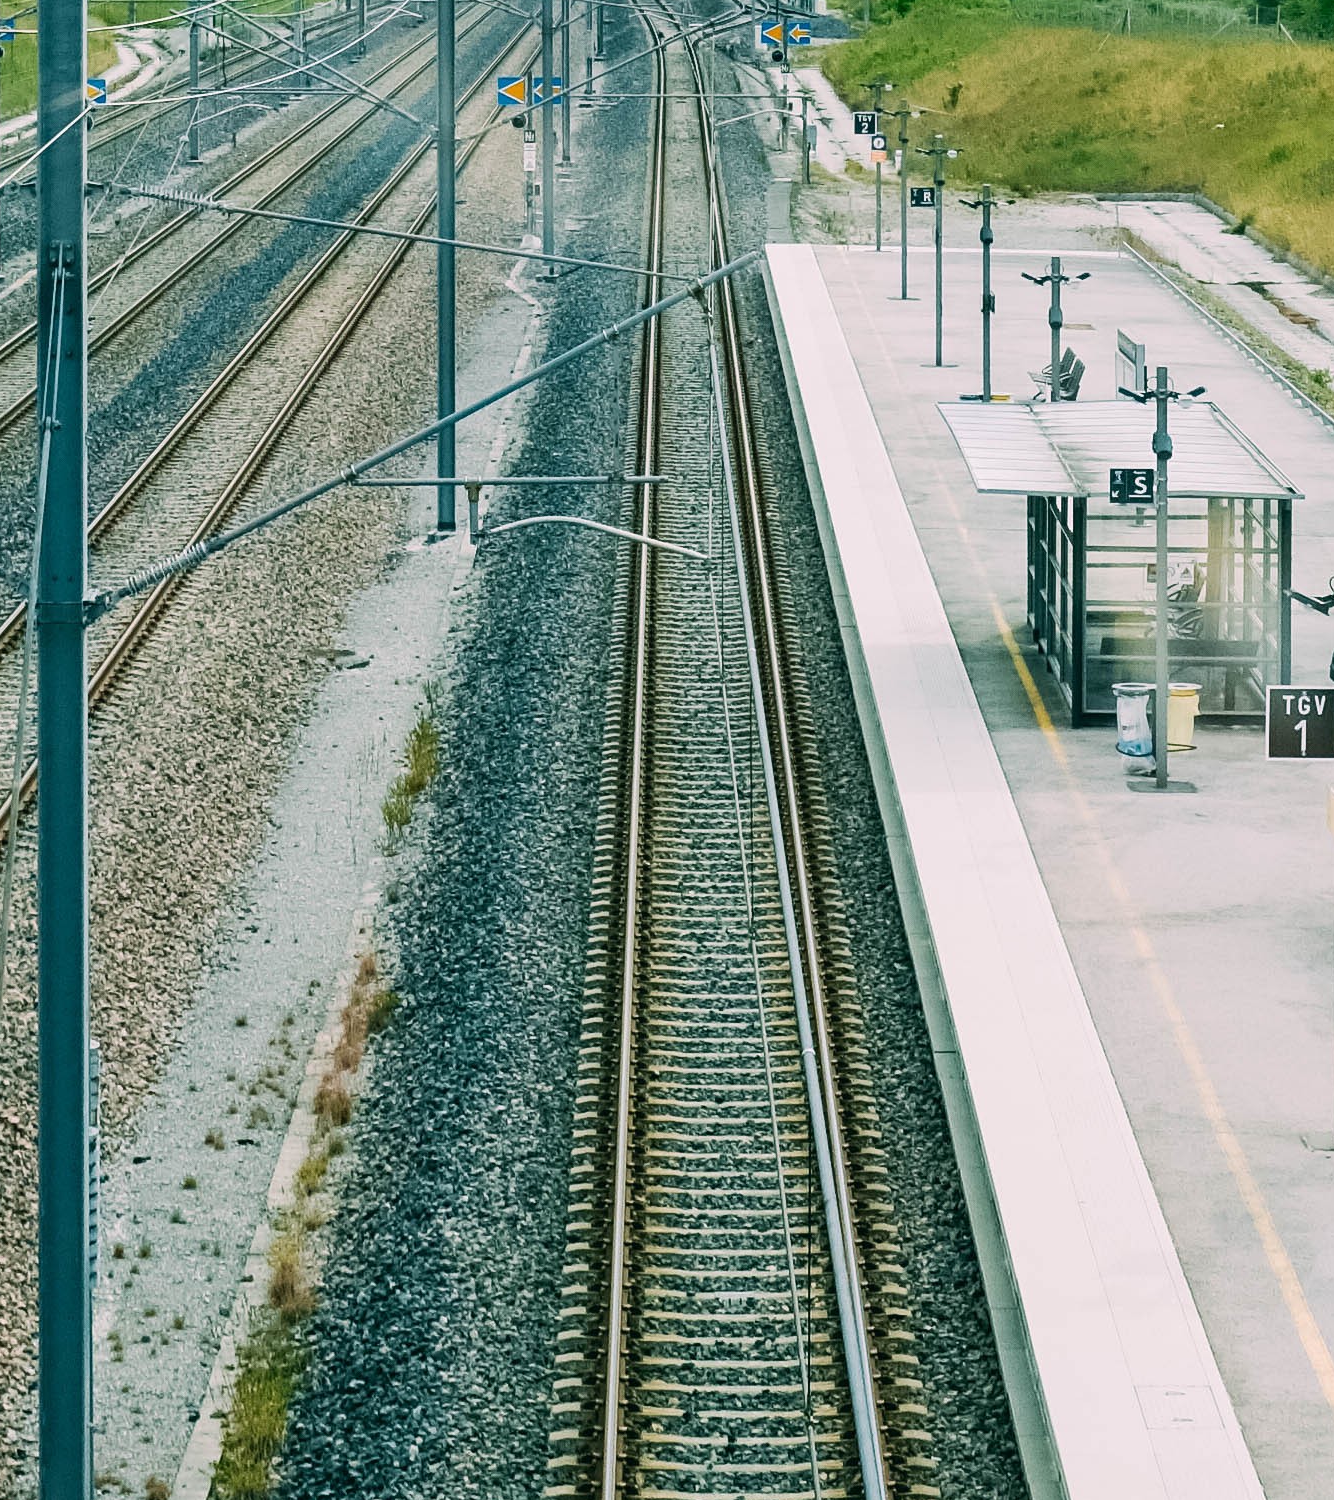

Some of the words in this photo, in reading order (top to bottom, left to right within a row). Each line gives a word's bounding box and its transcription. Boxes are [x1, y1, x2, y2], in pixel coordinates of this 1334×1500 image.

[857, 115, 873, 123] TGV
[861, 122, 869, 134] 2
[923, 191, 932, 202] R
[1133, 476, 1147, 495] S
[1282, 694, 1326, 716] TGV
[1294, 719, 1307, 753] 1
